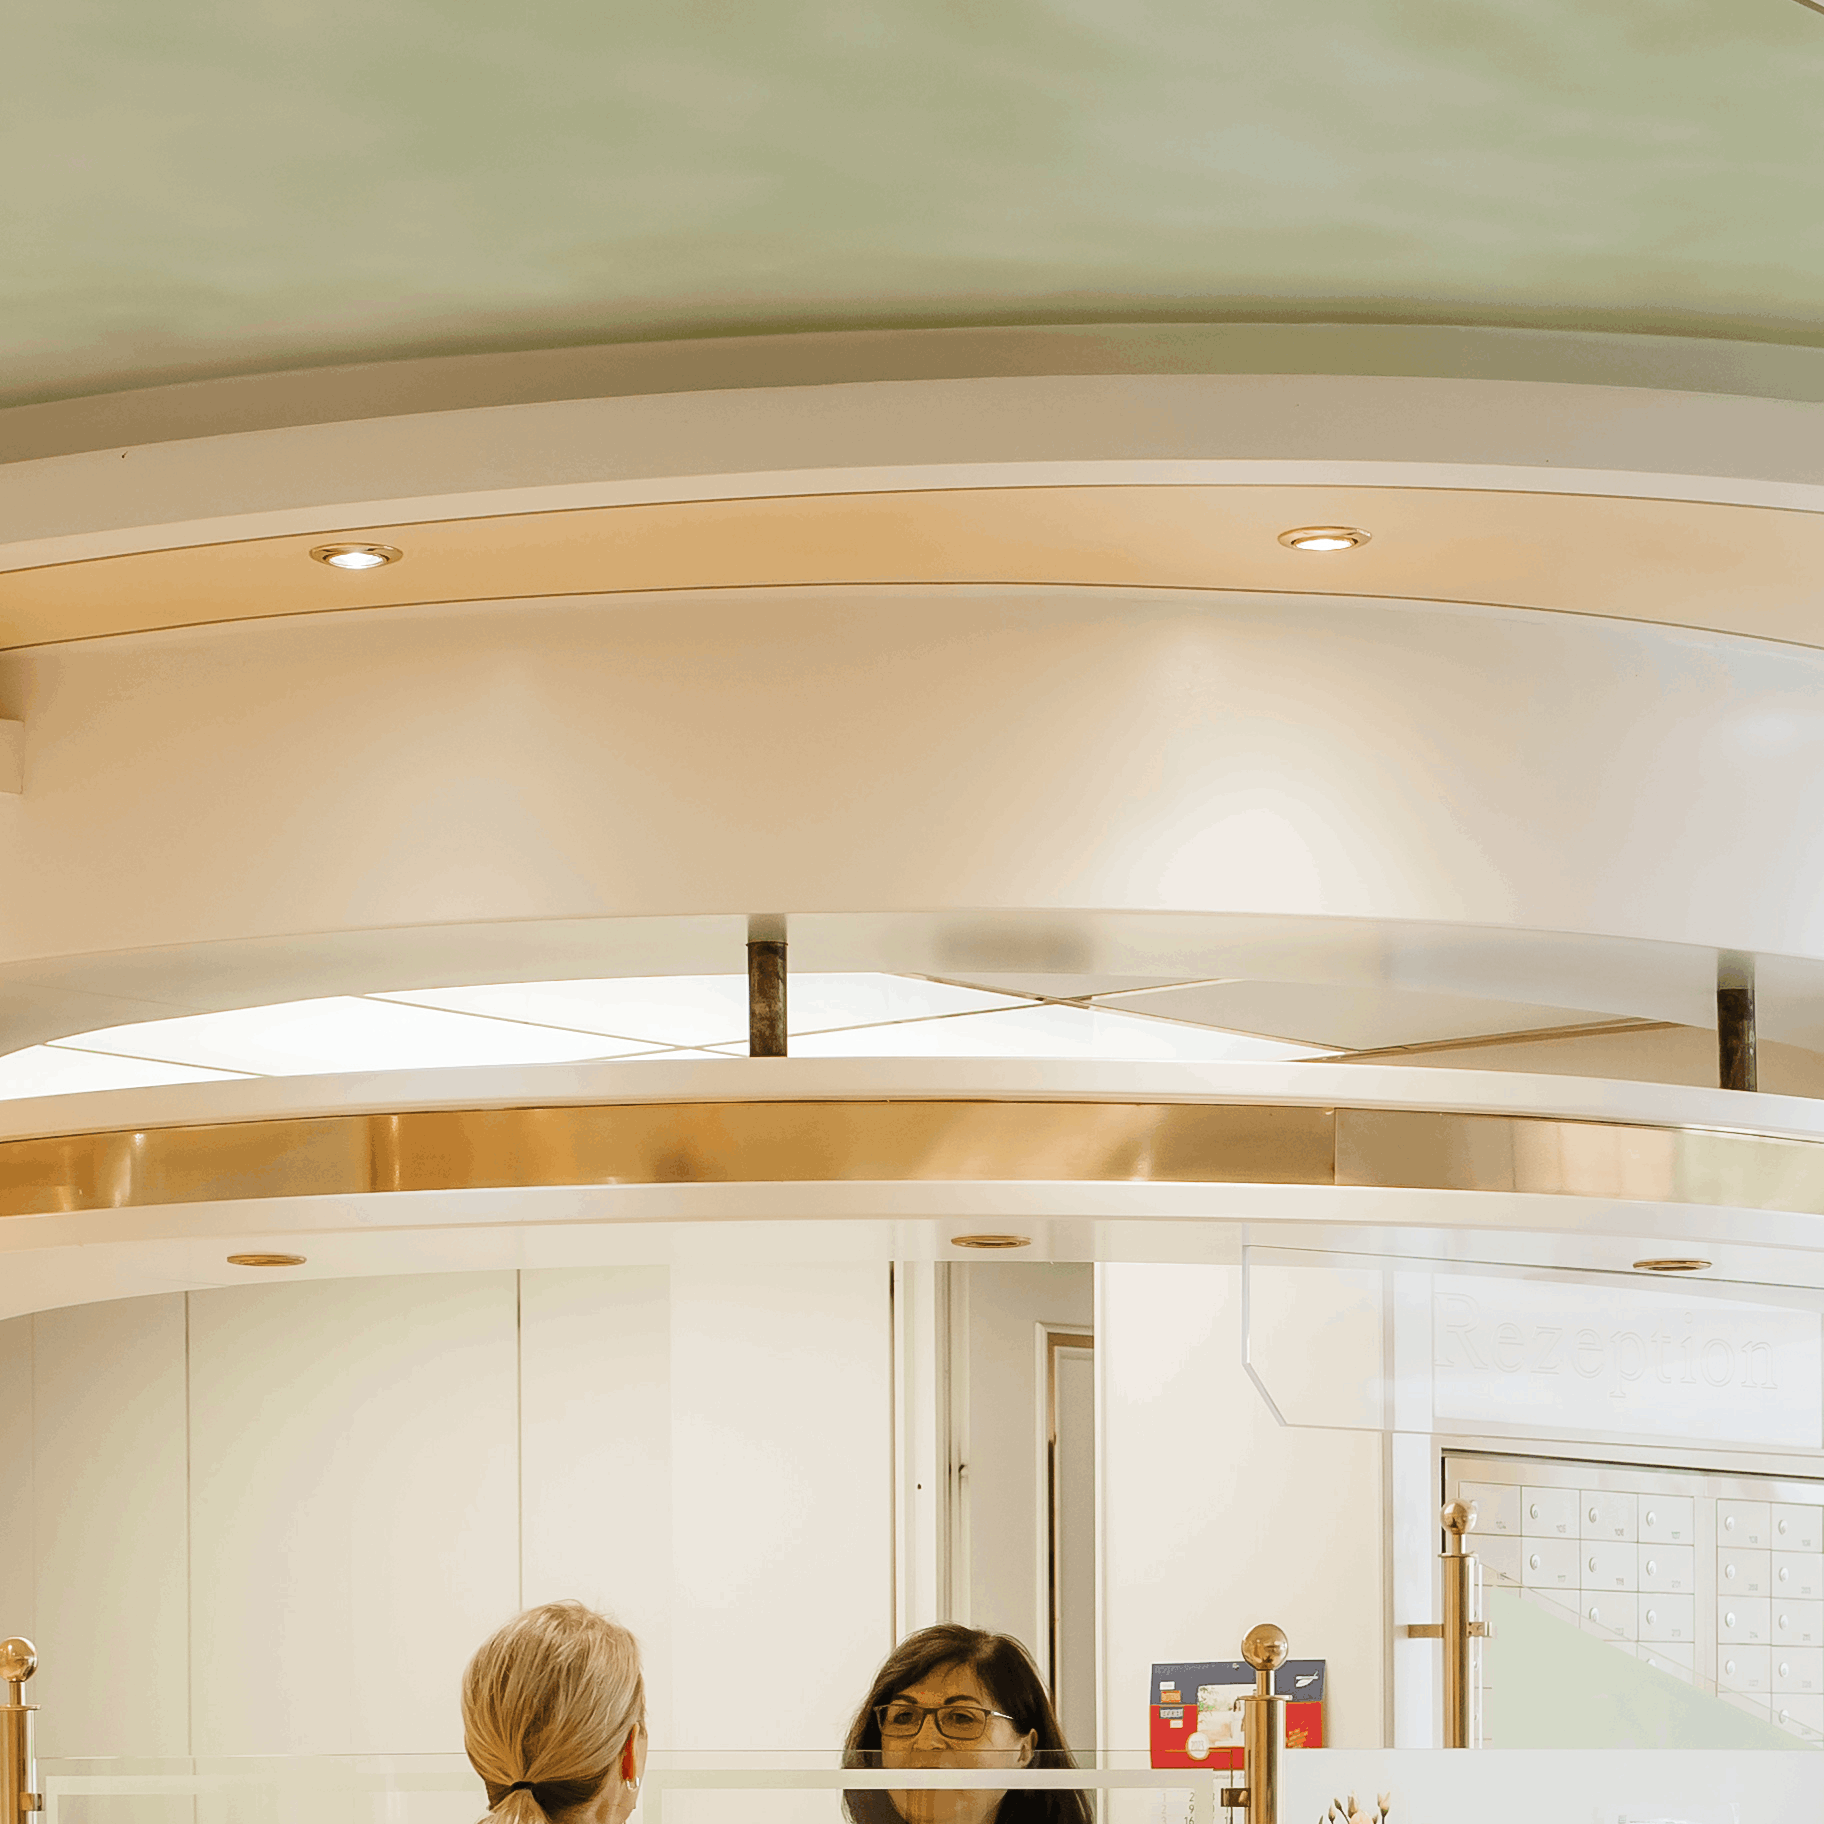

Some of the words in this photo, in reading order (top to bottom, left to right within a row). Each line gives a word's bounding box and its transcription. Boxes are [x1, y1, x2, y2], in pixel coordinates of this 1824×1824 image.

[1434, 1291, 1778, 1399] Rezeption
[1188, 1792, 1195, 1802] 2
[1188, 1804, 1194, 1814] 9
